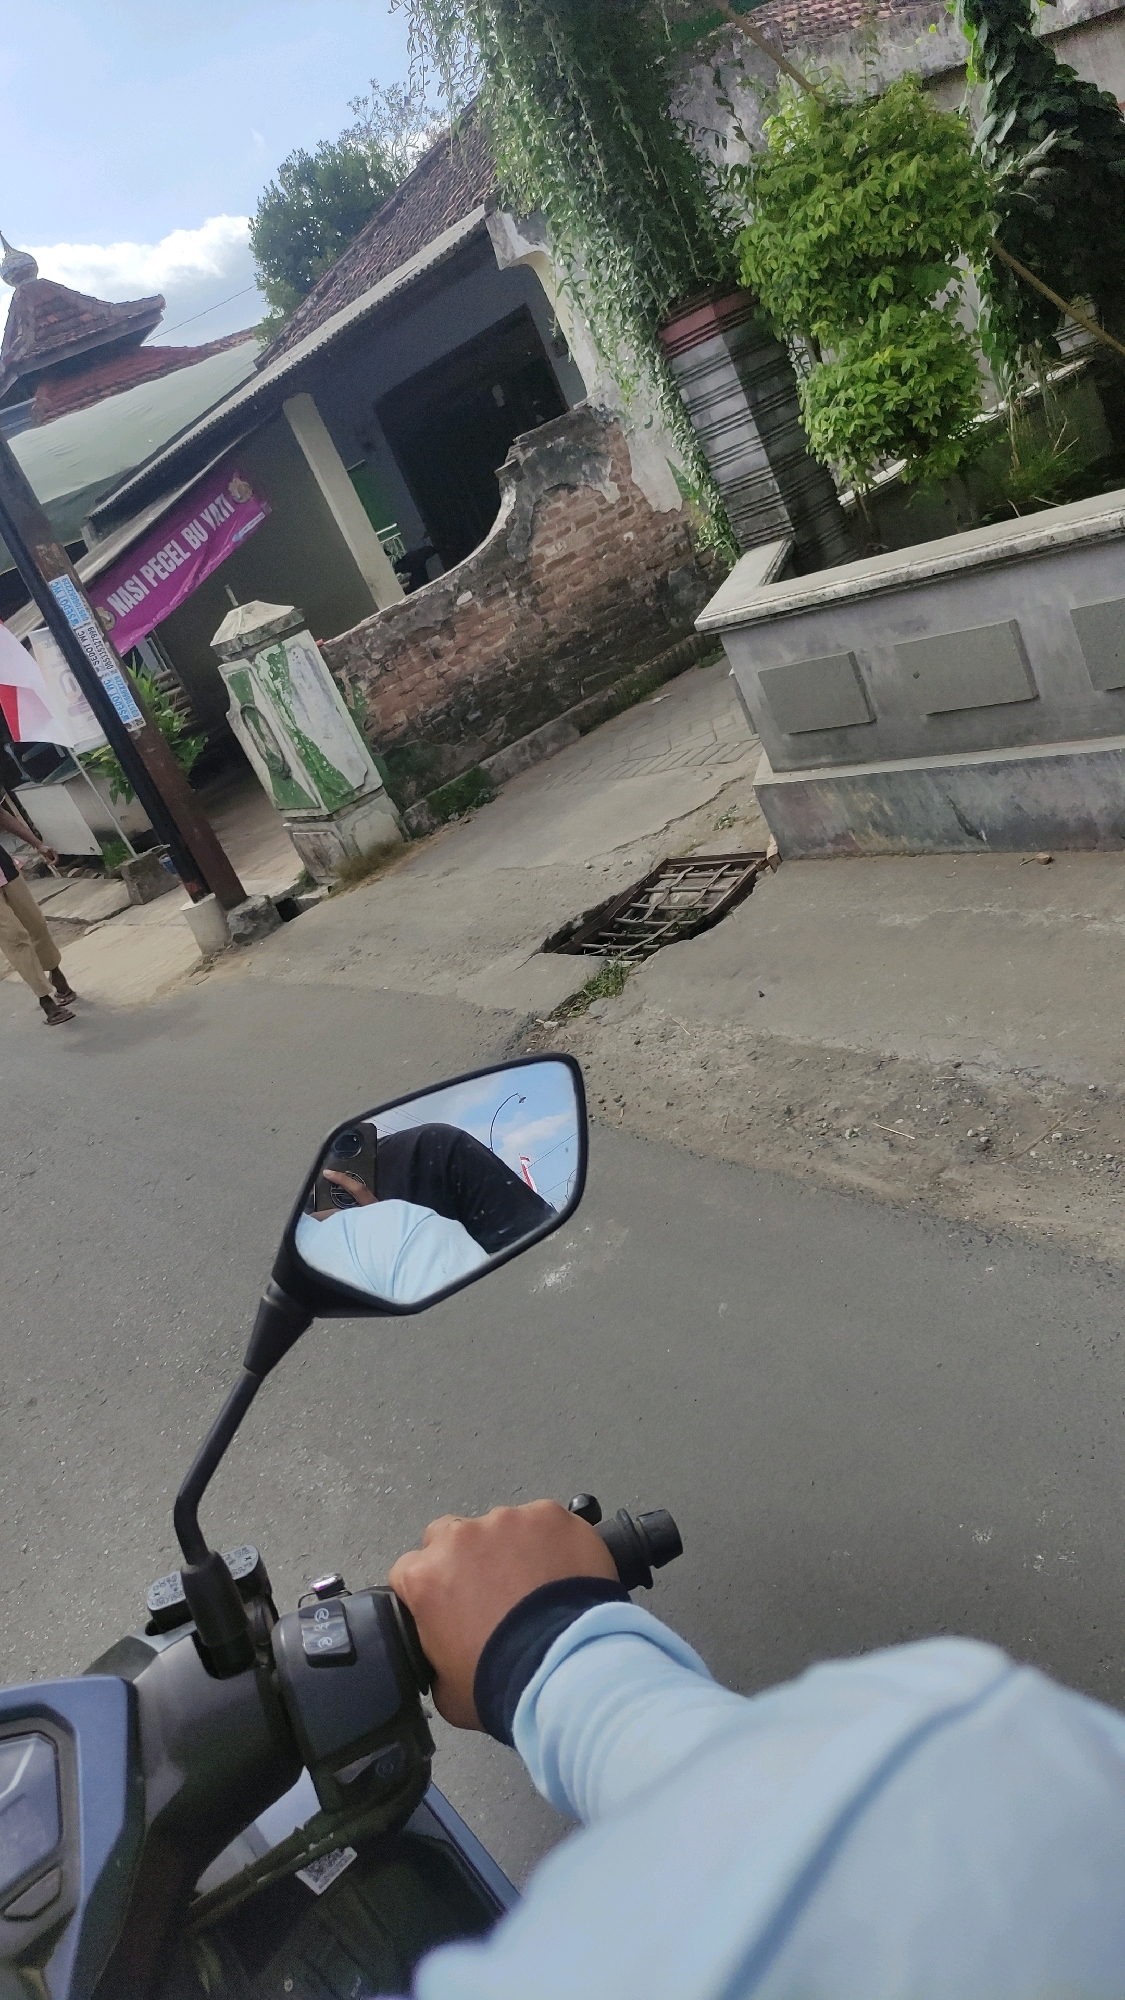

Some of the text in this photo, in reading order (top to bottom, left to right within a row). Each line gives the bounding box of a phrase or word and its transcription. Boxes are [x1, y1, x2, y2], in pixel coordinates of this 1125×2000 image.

[107, 574, 149, 617] NASI
[139, 539, 191, 587] PECEL
[181, 519, 208, 550] BU
[200, 493, 235, 531] YATI
[51, 581, 76, 620] SEDOT WC
[77, 630, 100, 666] SEDOT WC
[104, 679, 127, 716] SEDOT WC
[314, 1621, 330, 1631] OFF
